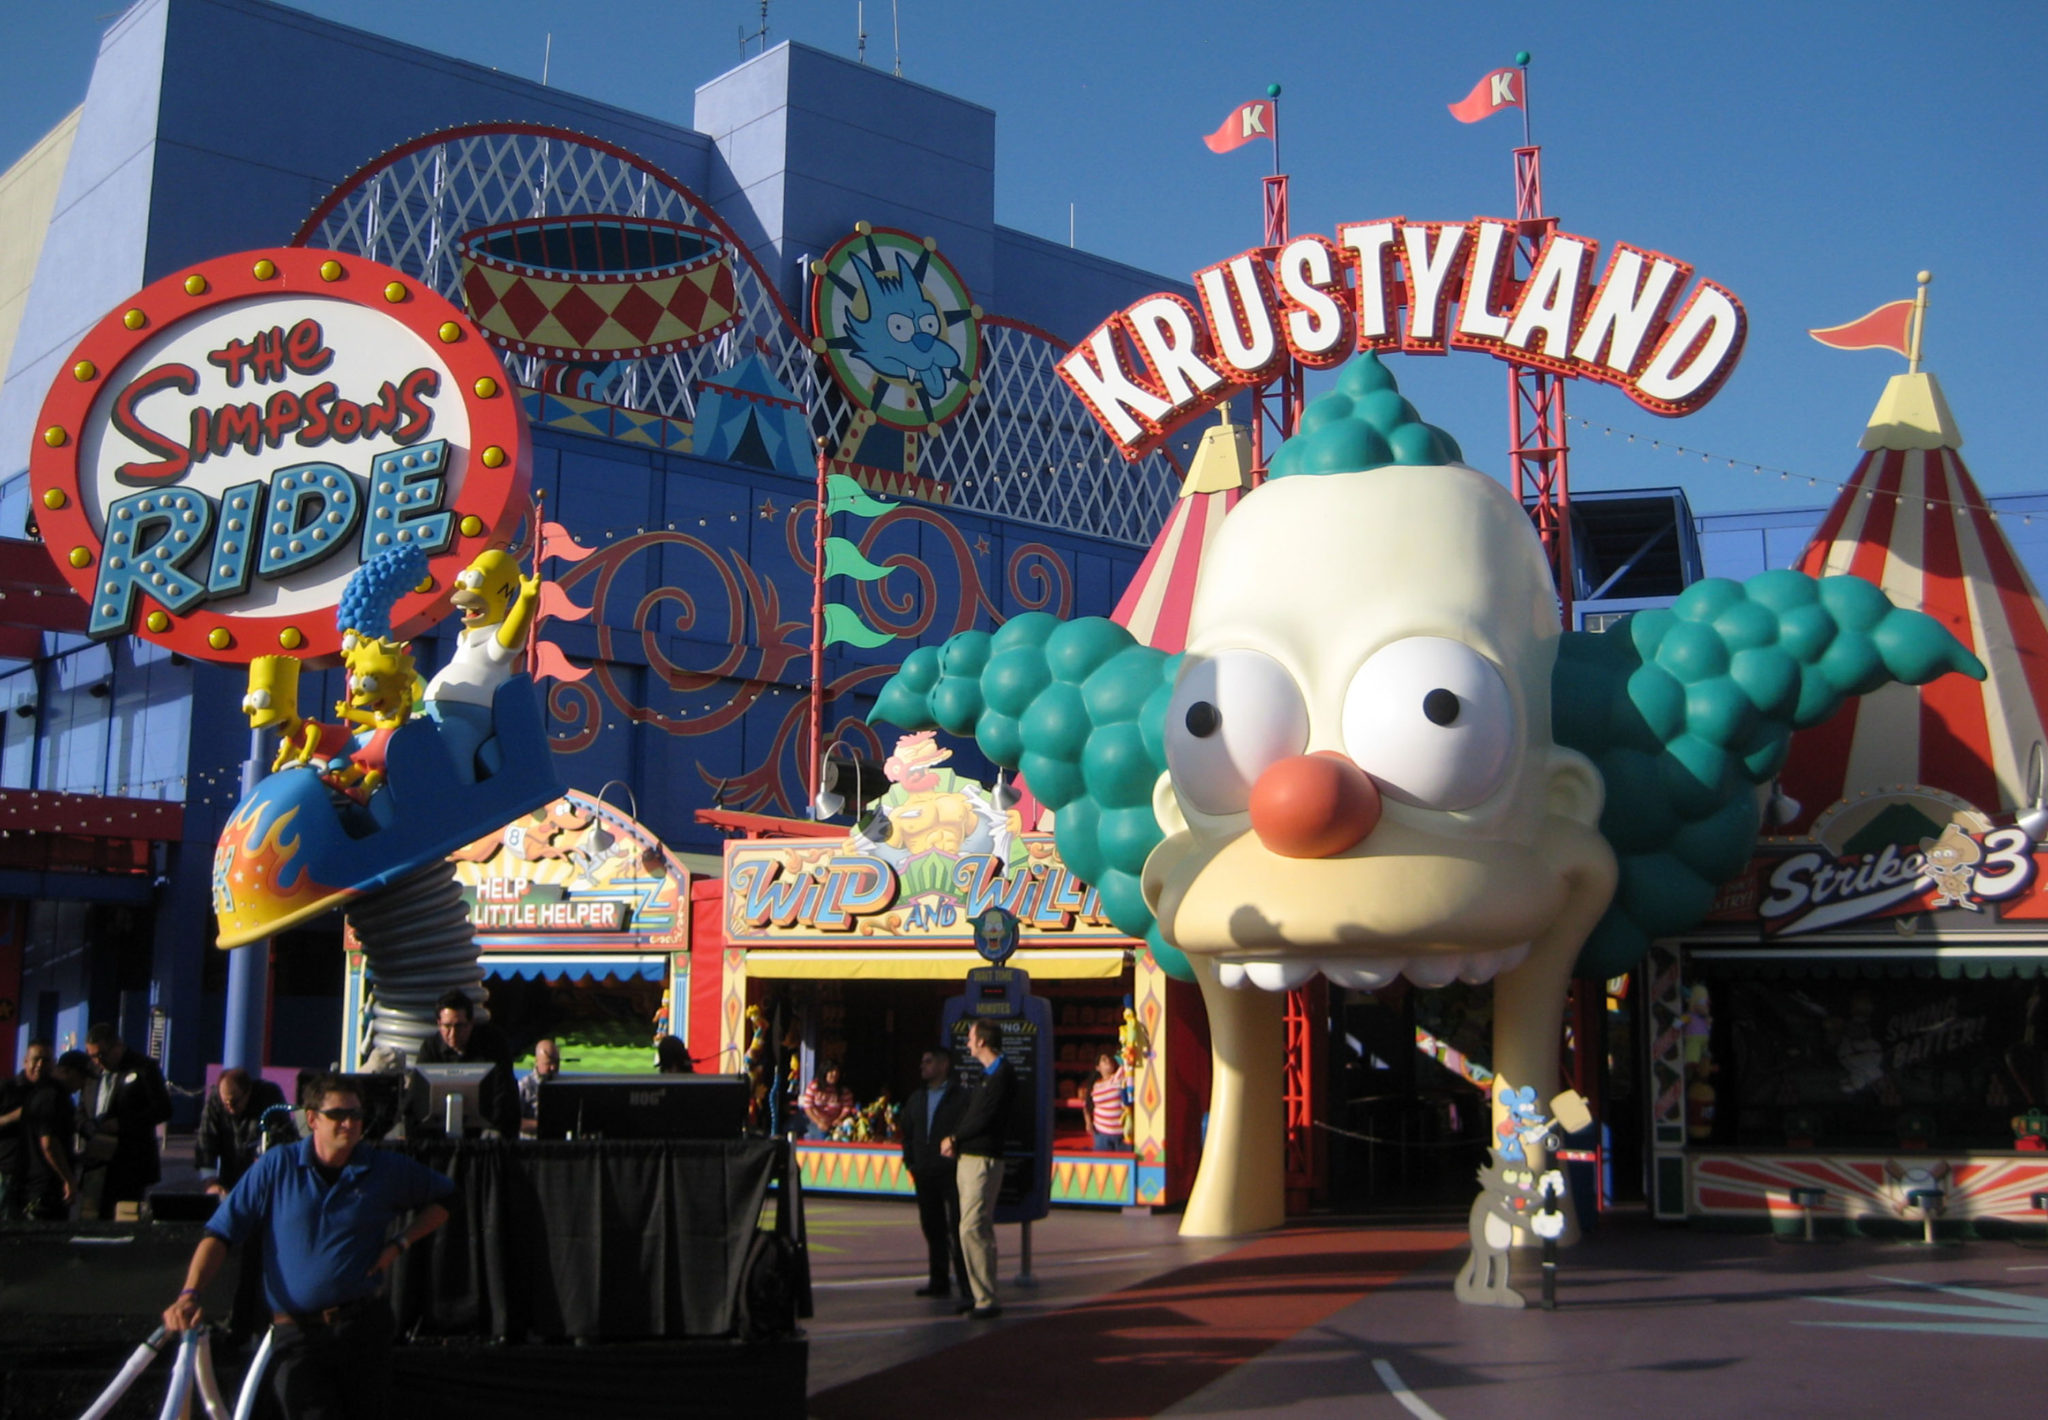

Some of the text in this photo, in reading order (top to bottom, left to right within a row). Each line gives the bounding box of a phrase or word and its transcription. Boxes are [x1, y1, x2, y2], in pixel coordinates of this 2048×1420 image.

[1490, 71, 1517, 107] K
[1241, 103, 1266, 138] K
[1054, 216, 1748, 462] KRUSTYLAND
[111, 362, 441, 486] SIMPSONS
[86, 438, 457, 639] RIDE
[212, 844, 236, 914] K
[476, 877, 530, 901] HELP
[1759, 828, 2031, 922] Strike 3
[474, 902, 618, 927] LITTLE HELPER
[903, 901, 956, 933] AND
